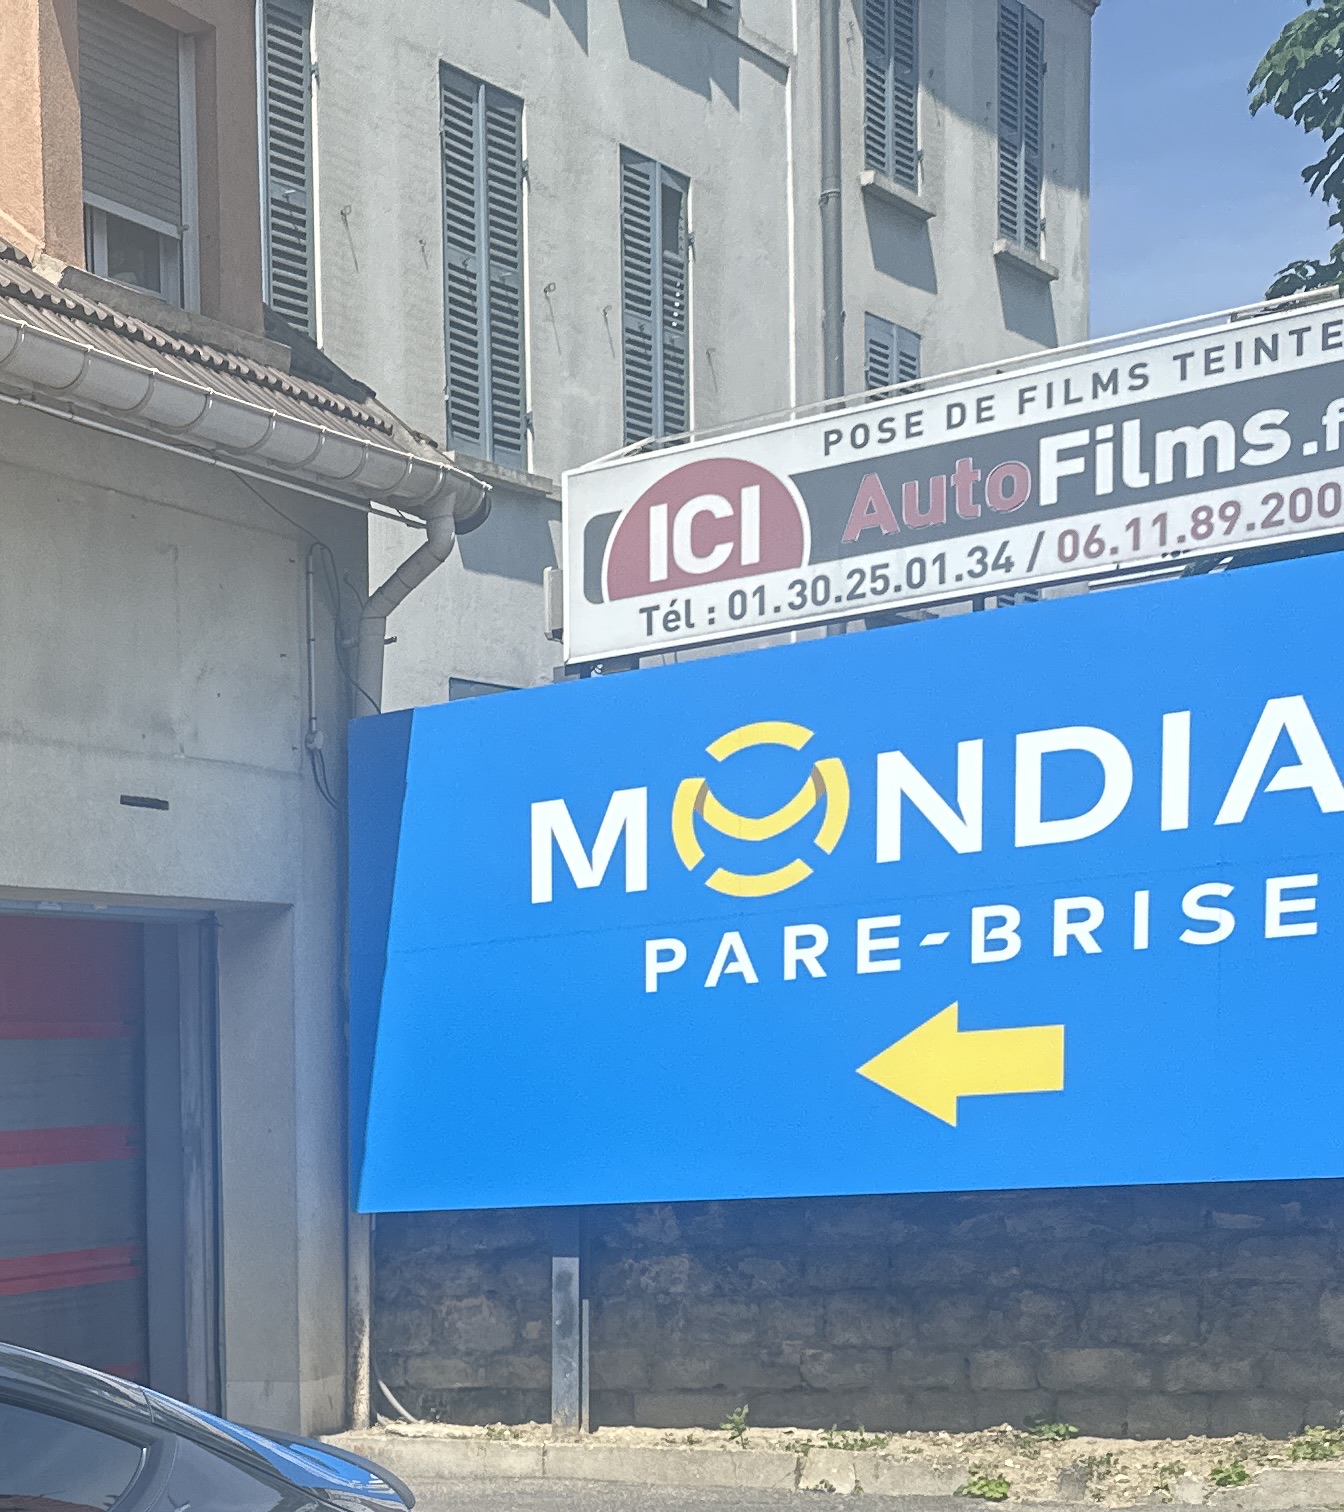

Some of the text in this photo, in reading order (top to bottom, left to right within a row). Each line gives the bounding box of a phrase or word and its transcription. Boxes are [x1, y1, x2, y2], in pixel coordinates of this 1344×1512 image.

[823, 319, 1344, 456] POSE DE FILMS TEINTE
[648, 484, 760, 582] ICI
[728, 541, 1015, 621] 01.30.25.01.34
[1056, 482, 1343, 564] 06.11.89.200
[530, 694, 1344, 905] MONDIA
[645, 873, 1319, 993] PARE-BRISE
